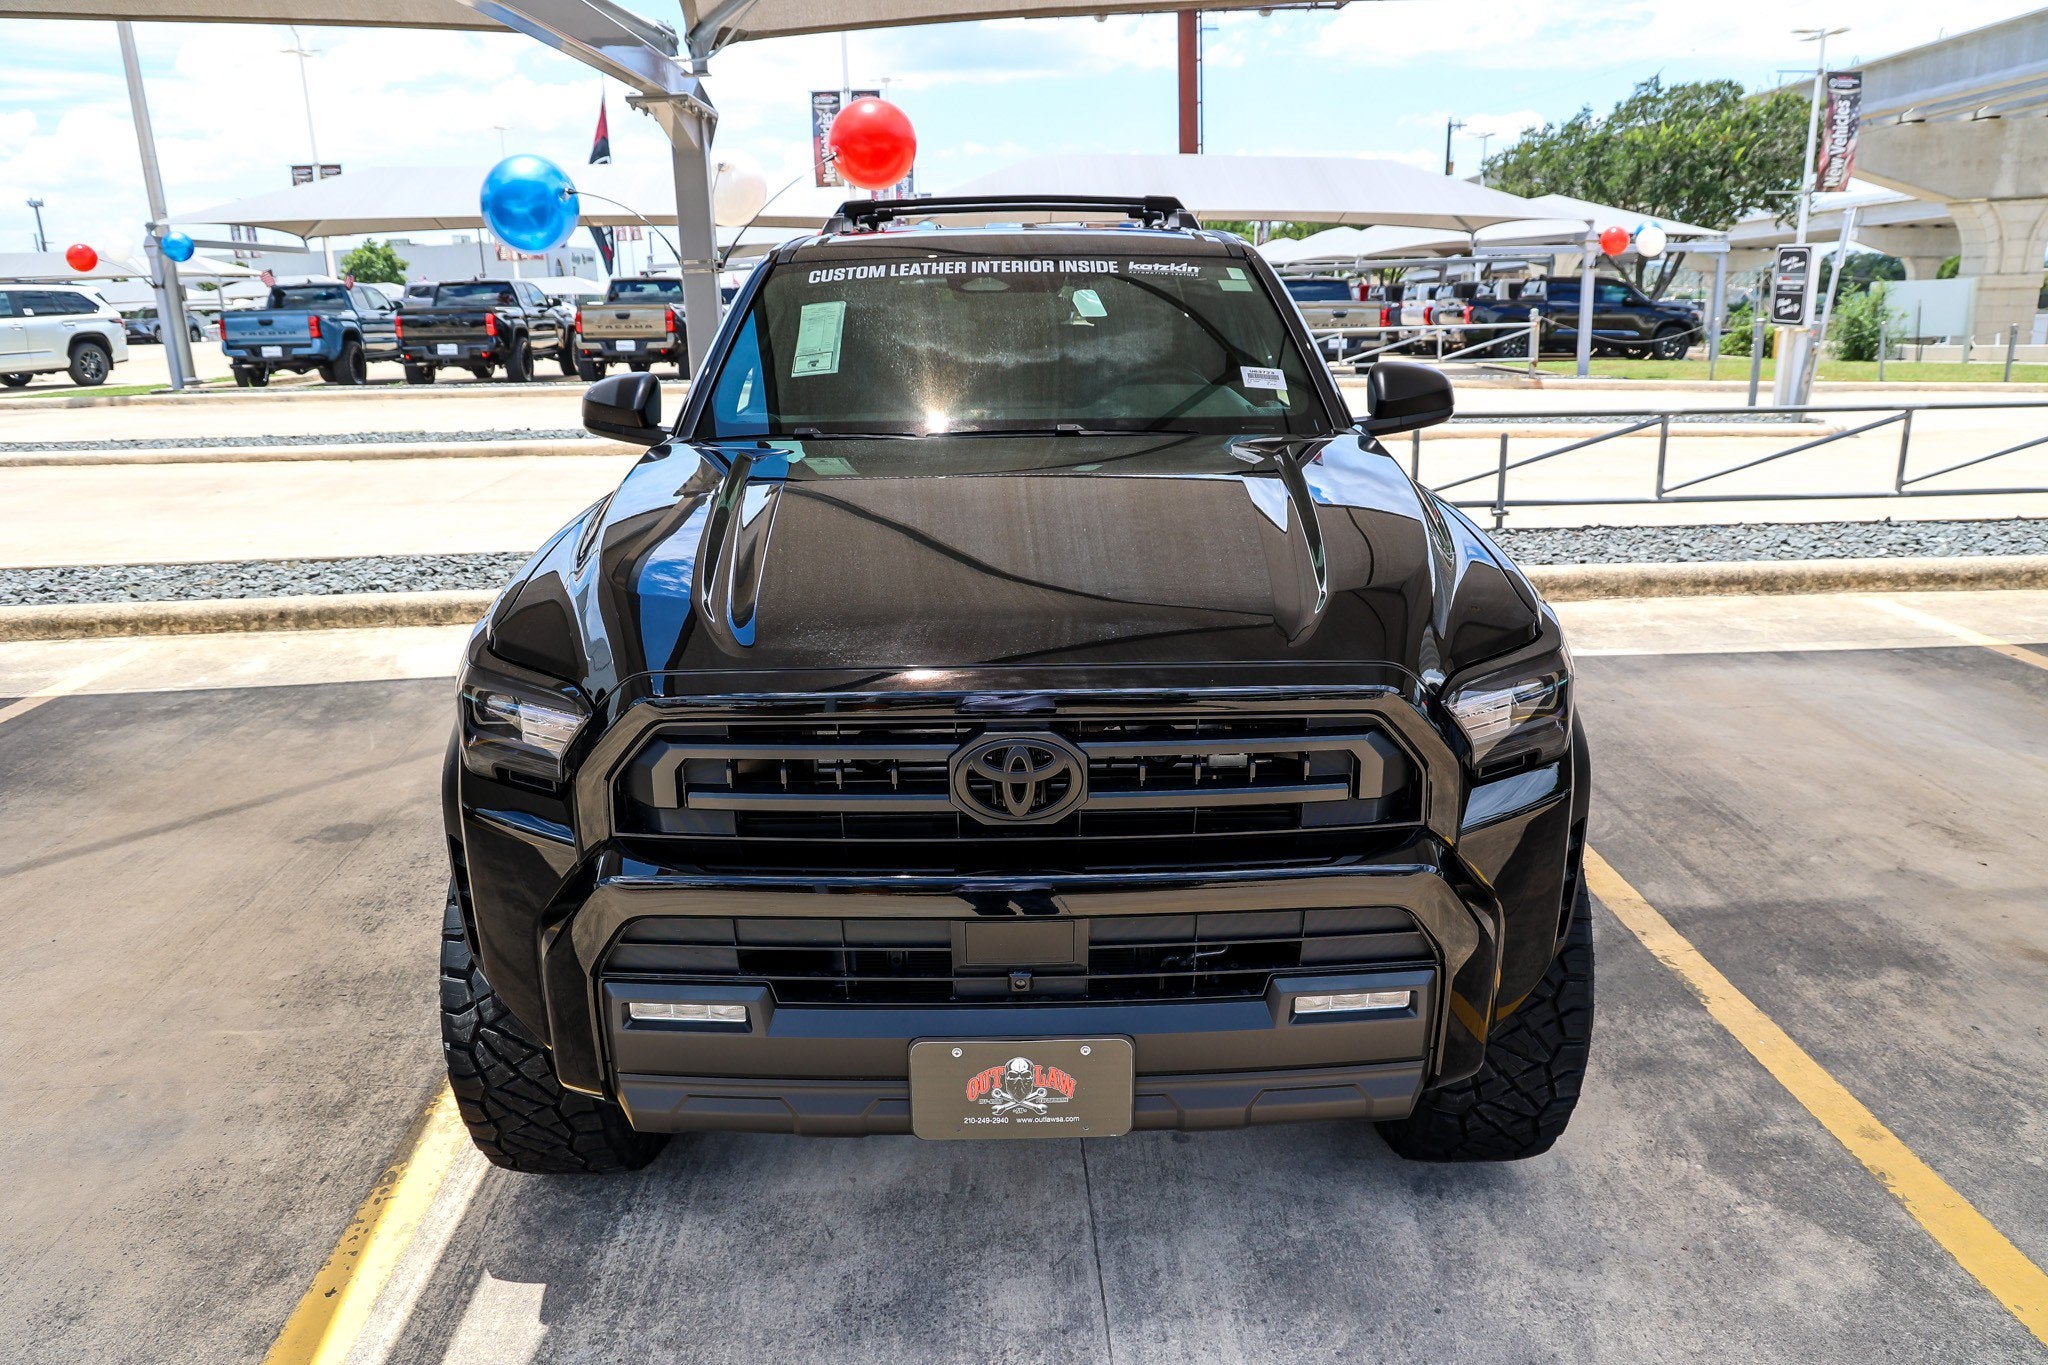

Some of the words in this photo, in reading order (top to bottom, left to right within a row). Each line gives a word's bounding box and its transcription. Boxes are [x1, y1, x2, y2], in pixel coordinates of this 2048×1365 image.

[1829, 99, 1851, 156] Vehicles
[1822, 157, 1844, 187] New
[808, 264, 887, 284] CUSTOM
[890, 261, 967, 277] LEATHER
[971, 260, 1055, 274] INTERIOR
[1059, 260, 1119, 274] INSIDE
[1128, 261, 1199, 273] katzkin
[966, 1065, 1005, 1101] OUT
[1033, 1065, 1077, 1099] LAW
